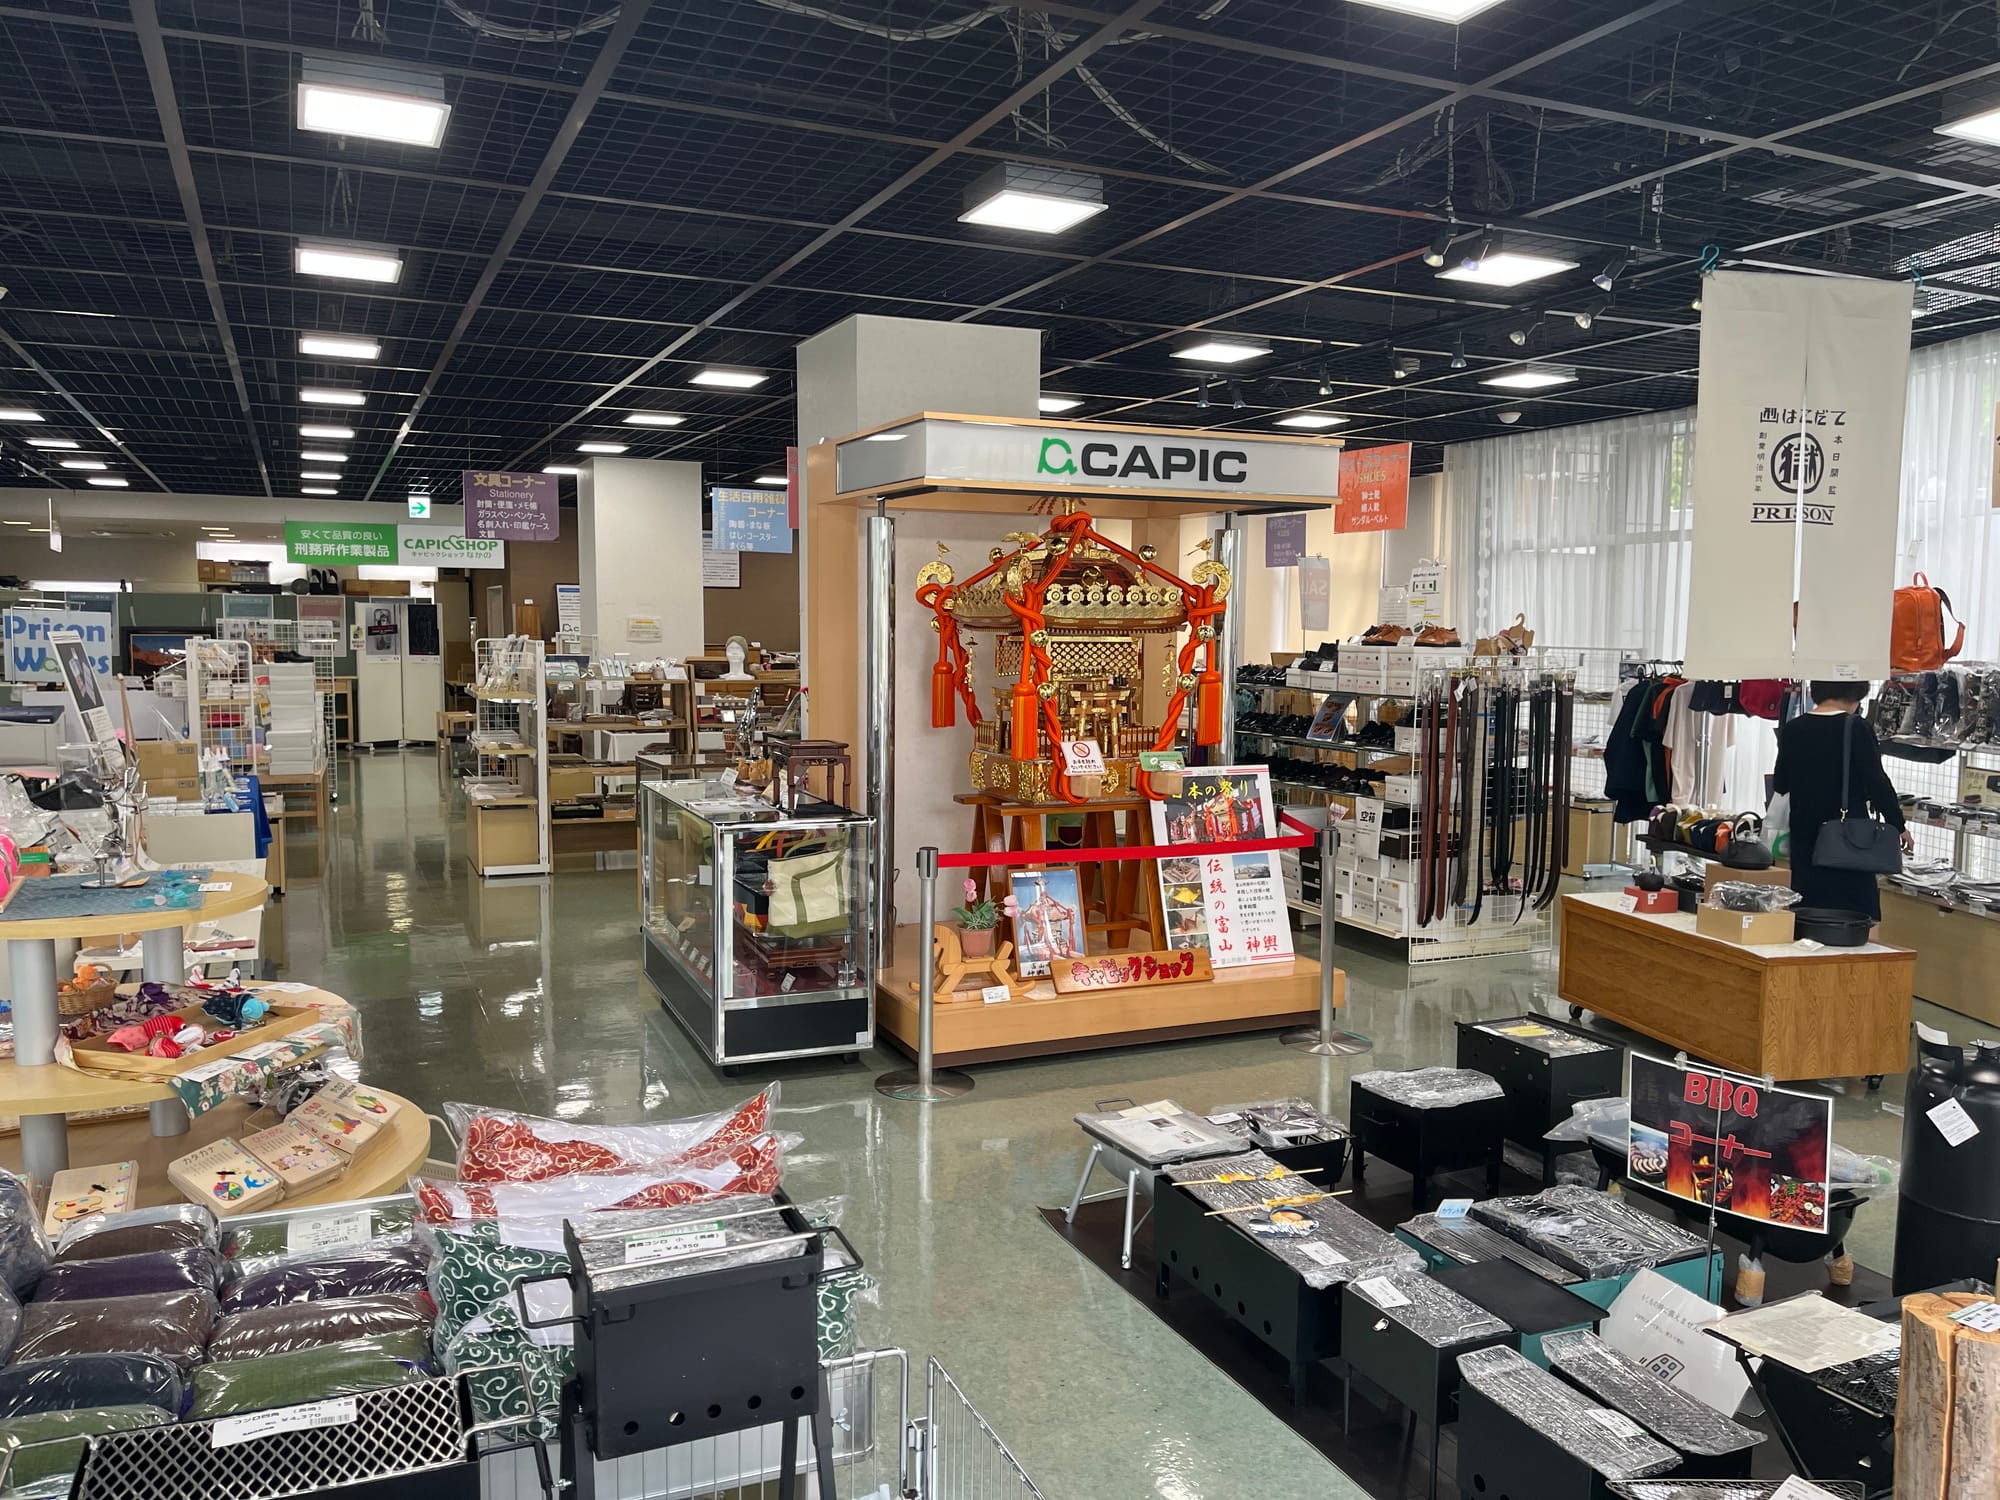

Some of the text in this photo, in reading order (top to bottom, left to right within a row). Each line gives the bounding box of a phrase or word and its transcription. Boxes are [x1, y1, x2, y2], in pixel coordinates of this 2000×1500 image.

[1081, 442, 1248, 483] CAPIC
[473, 473, 546, 488] 文具コーナー
[1359, 470, 1387, 484] SHOES
[489, 489, 534, 500] Stationery
[748, 507, 785, 518] コーナー
[301, 529, 383, 540] 安くて品質の良い
[294, 542, 390, 557] 刑務所作業製品
[1207, 858, 1233, 952] 伝統の富山
[1246, 935, 1278, 952] 神輿
[1071, 952, 1194, 986] キャピックショップ
[1684, 1073, 1758, 1119] BBQ
[1669, 1120, 1772, 1160] コーナー
